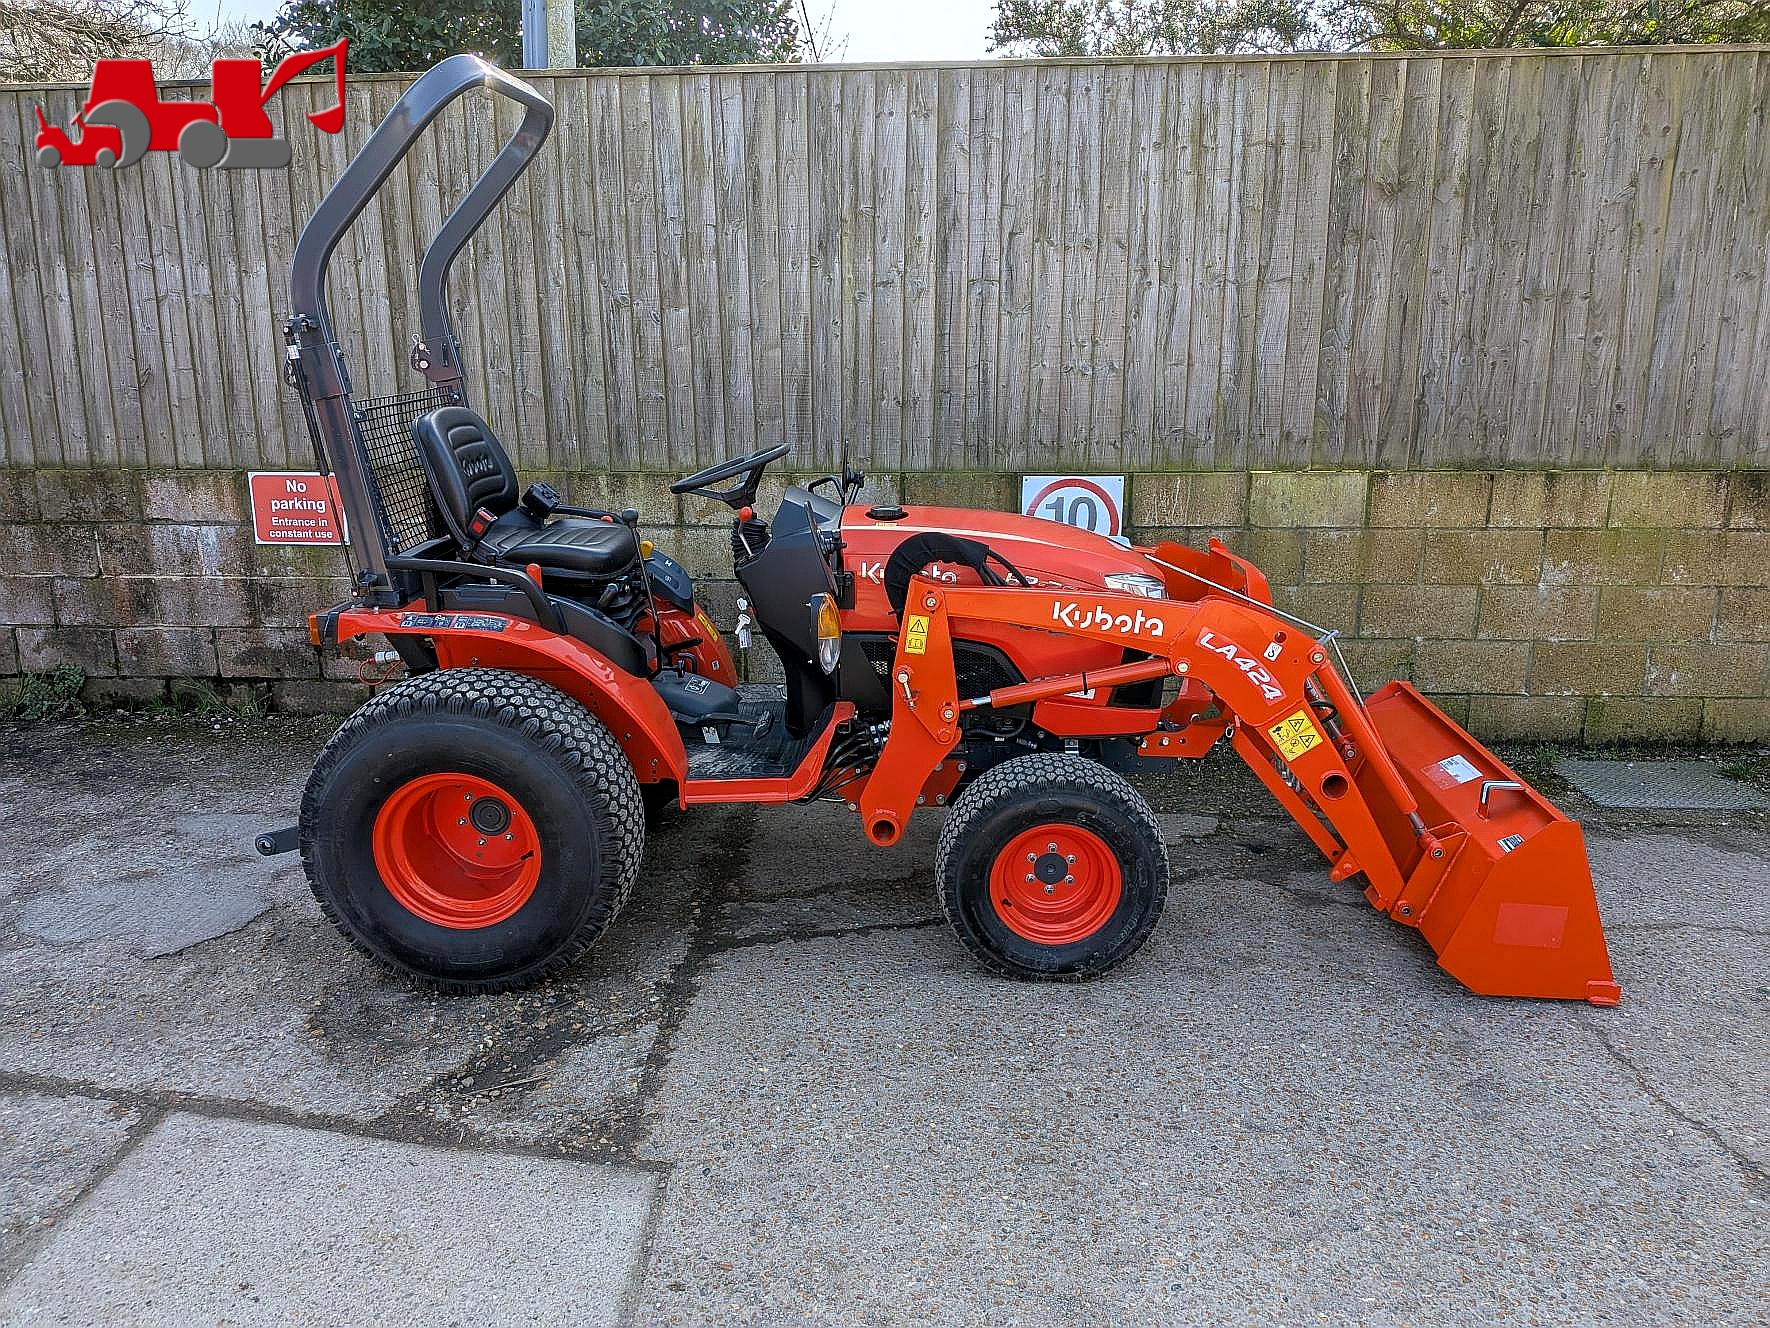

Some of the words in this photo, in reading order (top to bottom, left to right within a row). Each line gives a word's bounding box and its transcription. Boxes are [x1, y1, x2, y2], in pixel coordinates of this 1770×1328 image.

[286, 479, 307, 492] No
[271, 497, 325, 512] parking
[1045, 496, 1097, 531] 10
[271, 517, 315, 526] Entrance
[318, 517, 328, 526] in
[269, 529, 313, 538] constant
[315, 530, 333, 538] use
[1052, 601, 1164, 636] Kubota
[1199, 632, 1282, 700] LA424
